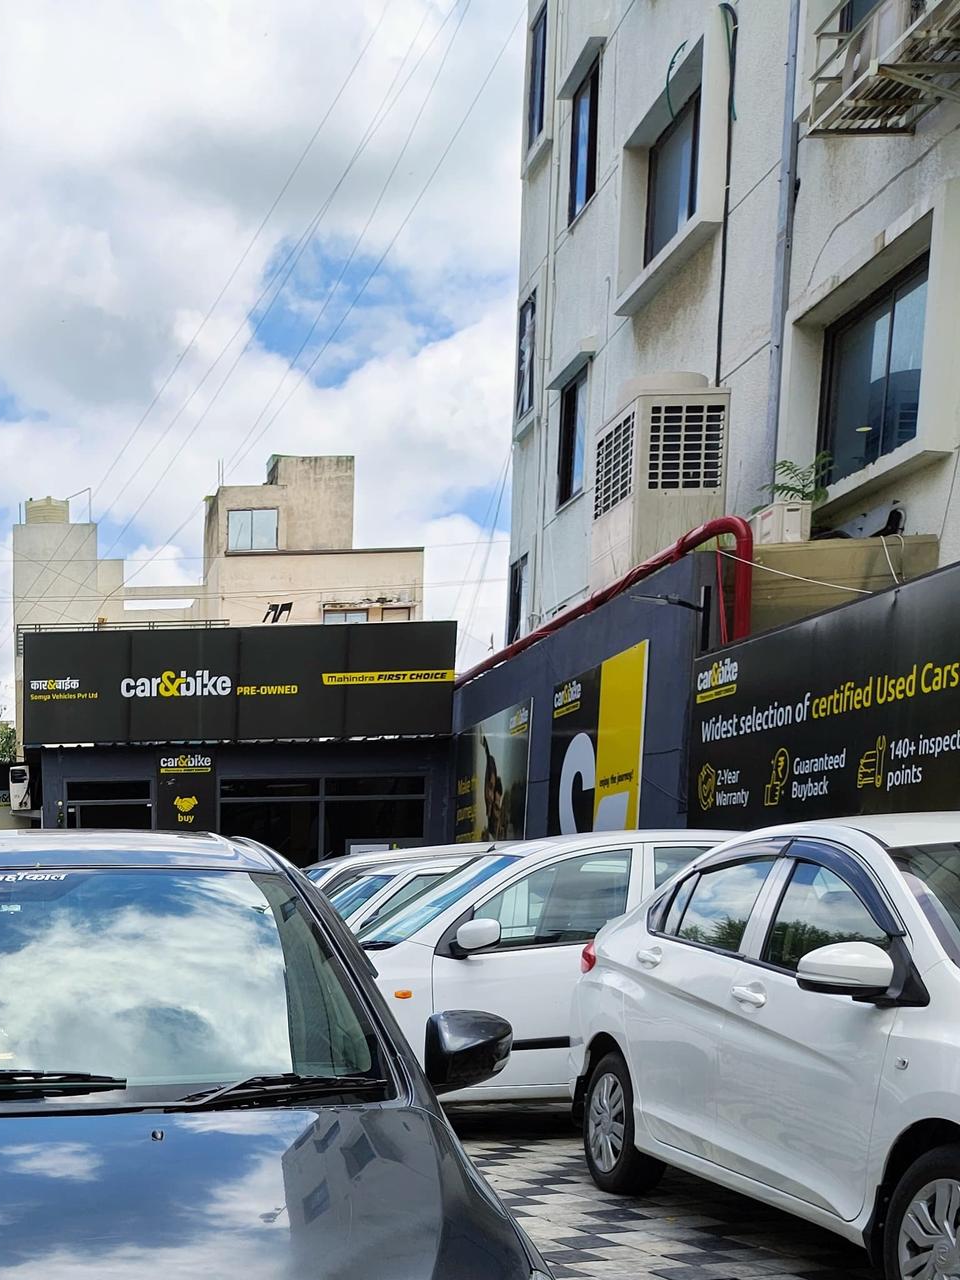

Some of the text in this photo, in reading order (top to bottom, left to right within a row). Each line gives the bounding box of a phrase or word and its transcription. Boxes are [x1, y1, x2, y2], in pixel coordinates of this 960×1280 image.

[120, 670, 298, 697] car&bike PRE-OWNED
[327, 671, 447, 683] Mahindra FIRST CHOICE
[697, 657, 739, 690] car&bike
[52, 692, 76, 700] Vehicles
[88, 691, 98, 699] Ltd
[553, 680, 582, 708] car&bike
[701, 662, 960, 743] Widest selection of certified Used Cars
[890, 729, 960, 760] 140+ inspect
[160, 755, 212, 767] car&bike
[793, 748, 846, 776] Guaranteed
[716, 769, 740, 786] 2-Year
[791, 776, 829, 802] Buyback
[887, 765, 923, 792] points
[715, 789, 750, 808] Warranty
[178, 813, 195, 824] buy
